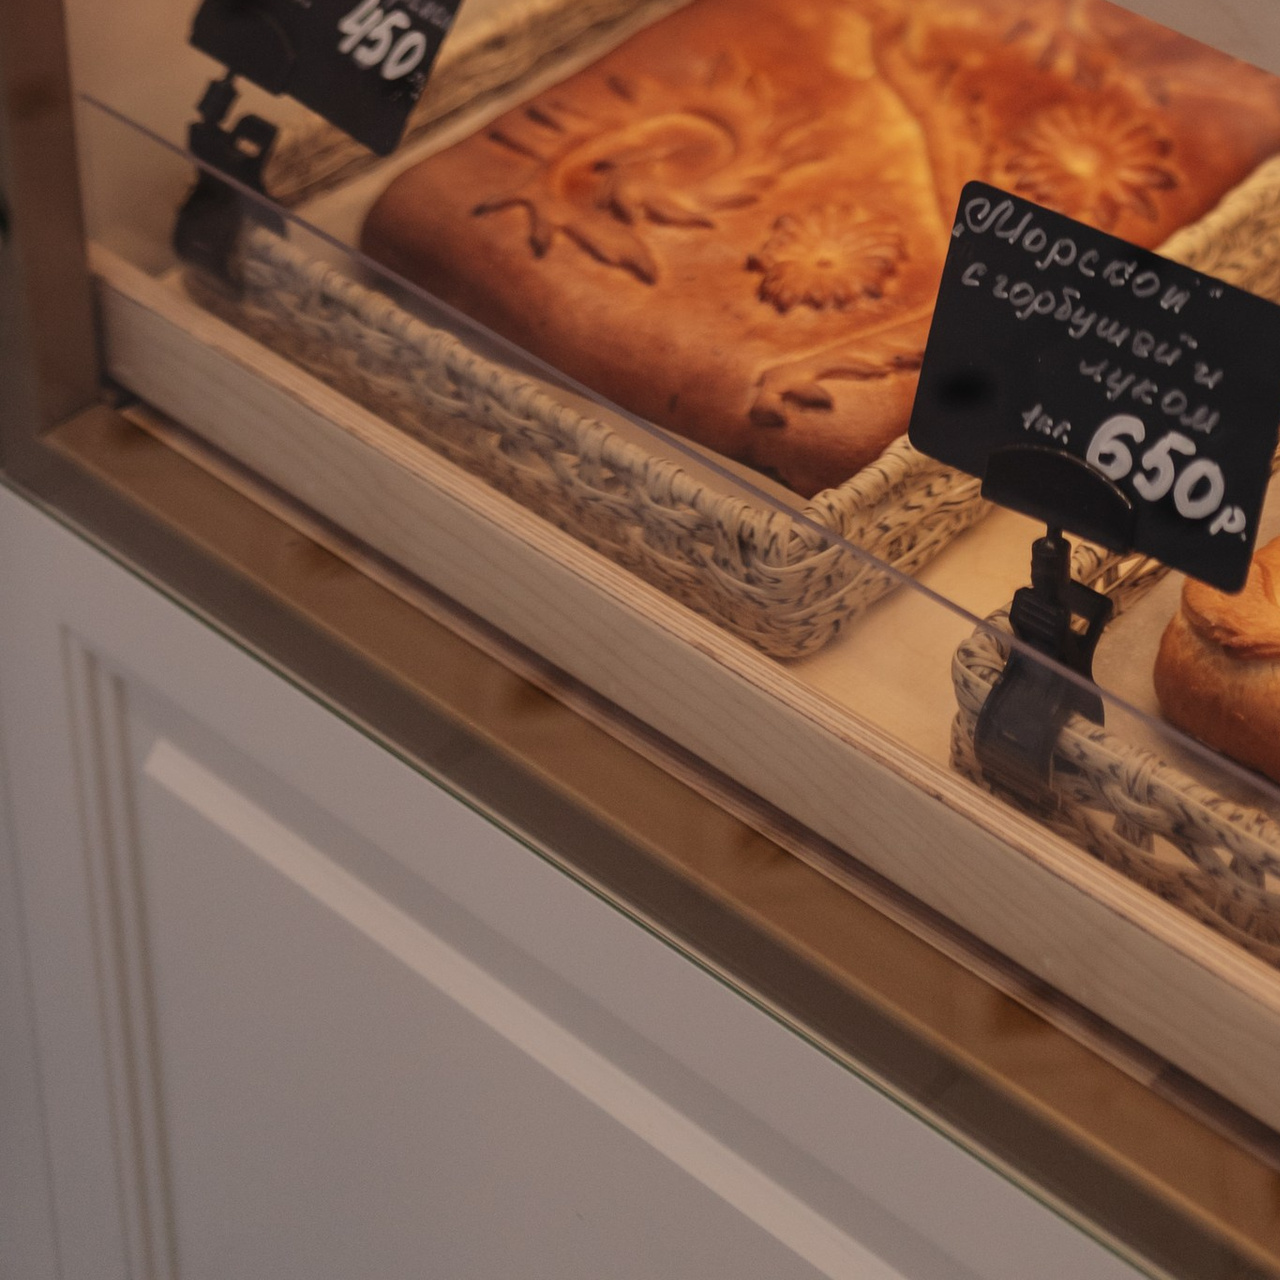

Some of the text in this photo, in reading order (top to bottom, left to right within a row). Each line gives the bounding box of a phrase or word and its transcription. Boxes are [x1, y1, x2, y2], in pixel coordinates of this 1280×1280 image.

[961, 262, 988, 287] с
[1194, 362, 1224, 389] и
[1078, 356, 1221, 435] луком
